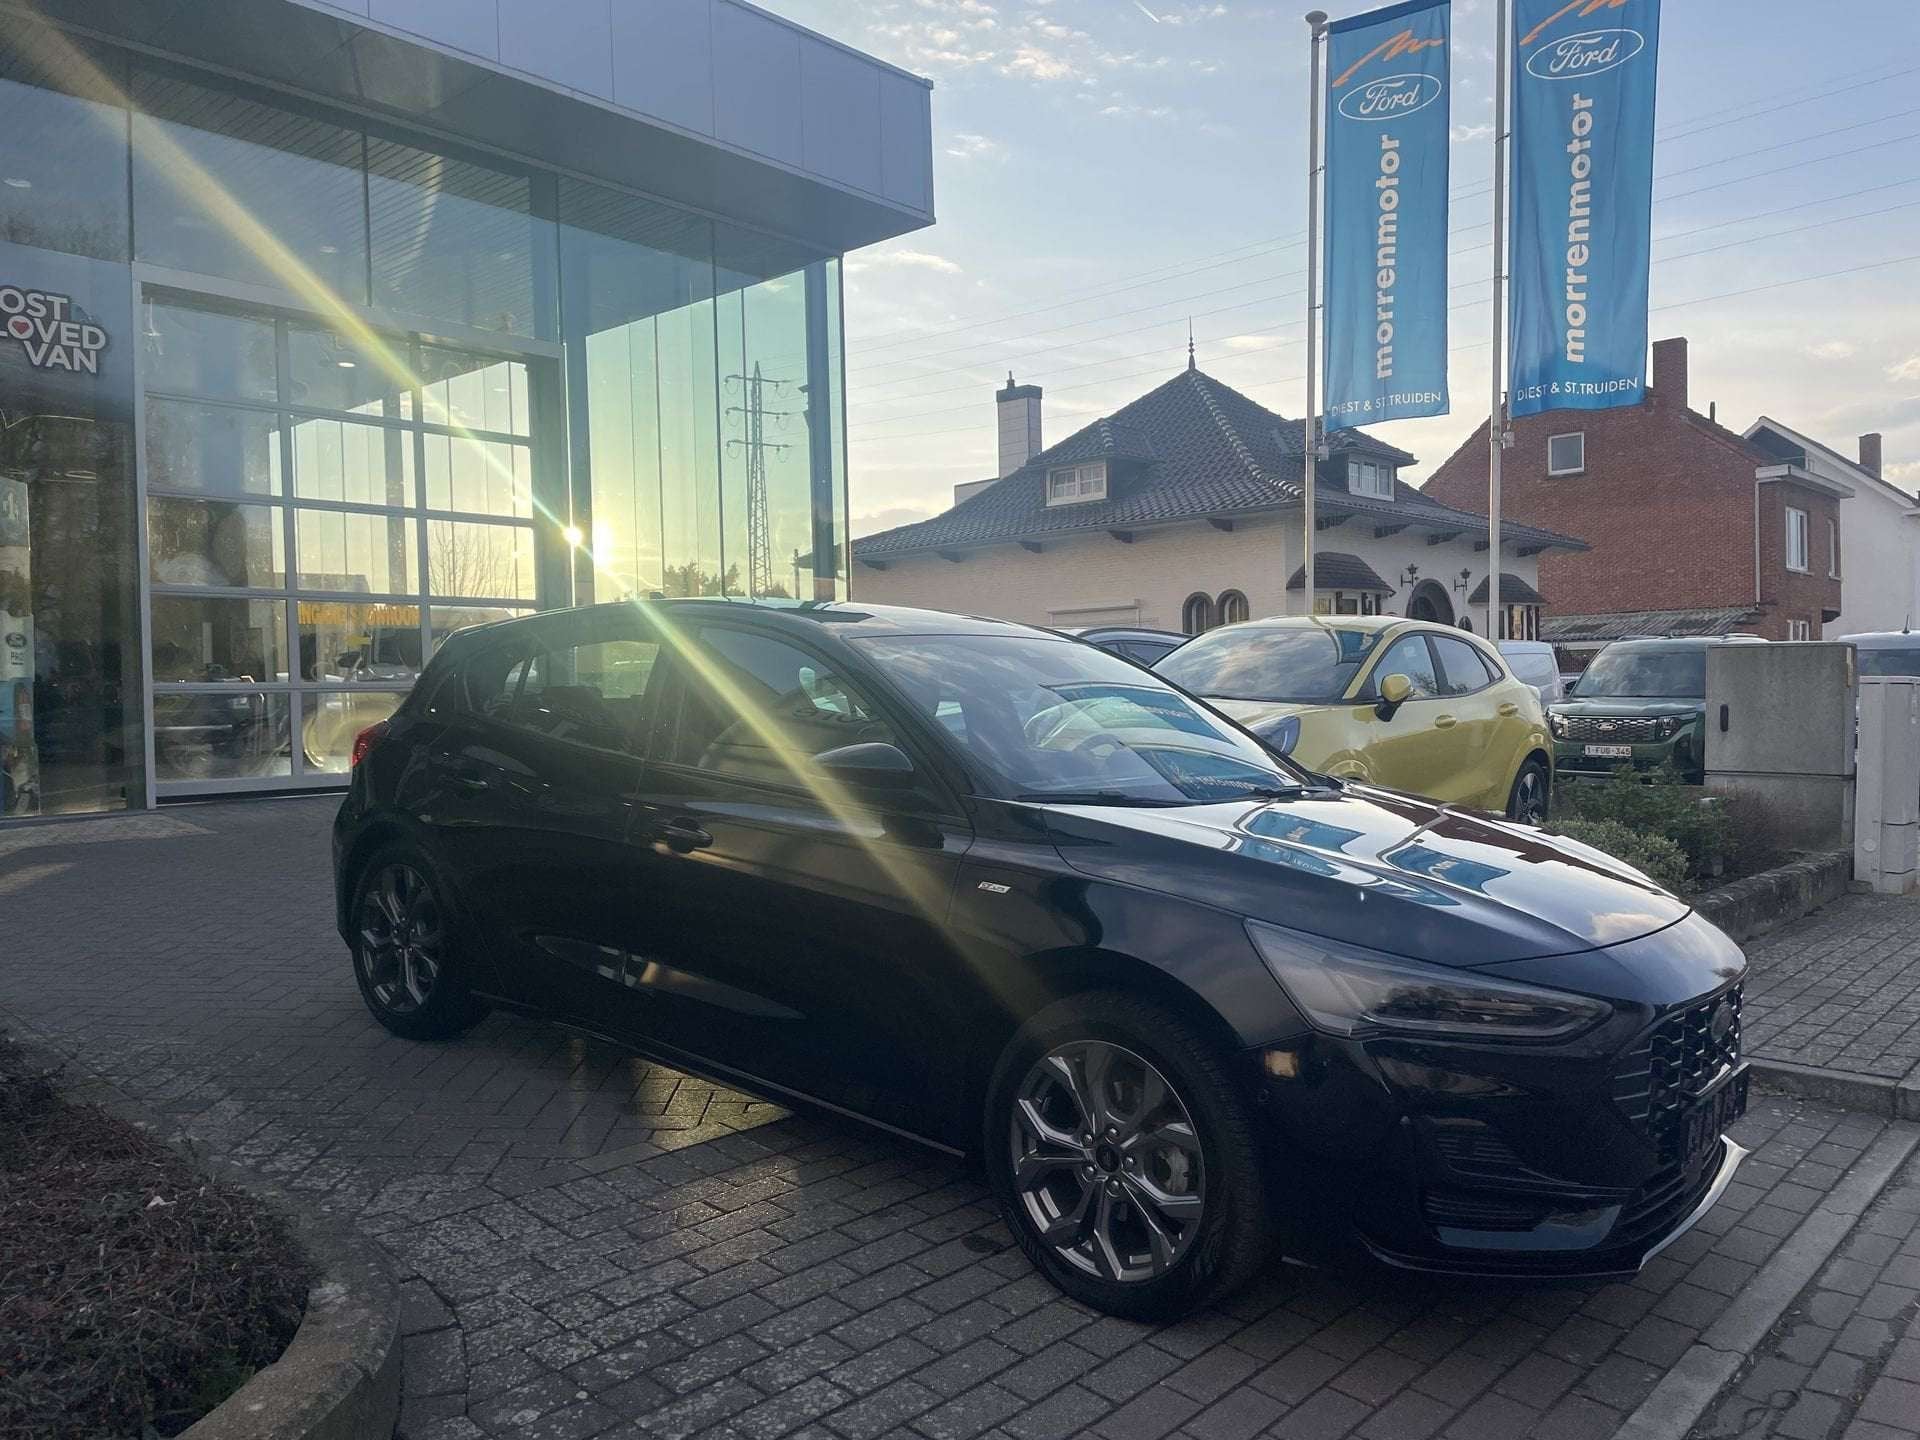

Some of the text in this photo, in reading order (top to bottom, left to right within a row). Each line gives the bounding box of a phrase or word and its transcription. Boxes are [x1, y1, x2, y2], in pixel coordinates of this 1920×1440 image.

[1549, 35, 1620, 73] Ford
[1359, 80, 1420, 114] Ford
[1566, 93, 1594, 363] morrenmotor
[1375, 134, 1400, 379] morrenmotor
[0, 315, 106, 350] OVED
[23, 340, 97, 374] VAN
[1331, 401, 1360, 417] DIEST
[1363, 400, 1373, 412] &
[1517, 384, 1548, 401] DIEST
[1550, 382, 1560, 394] &
